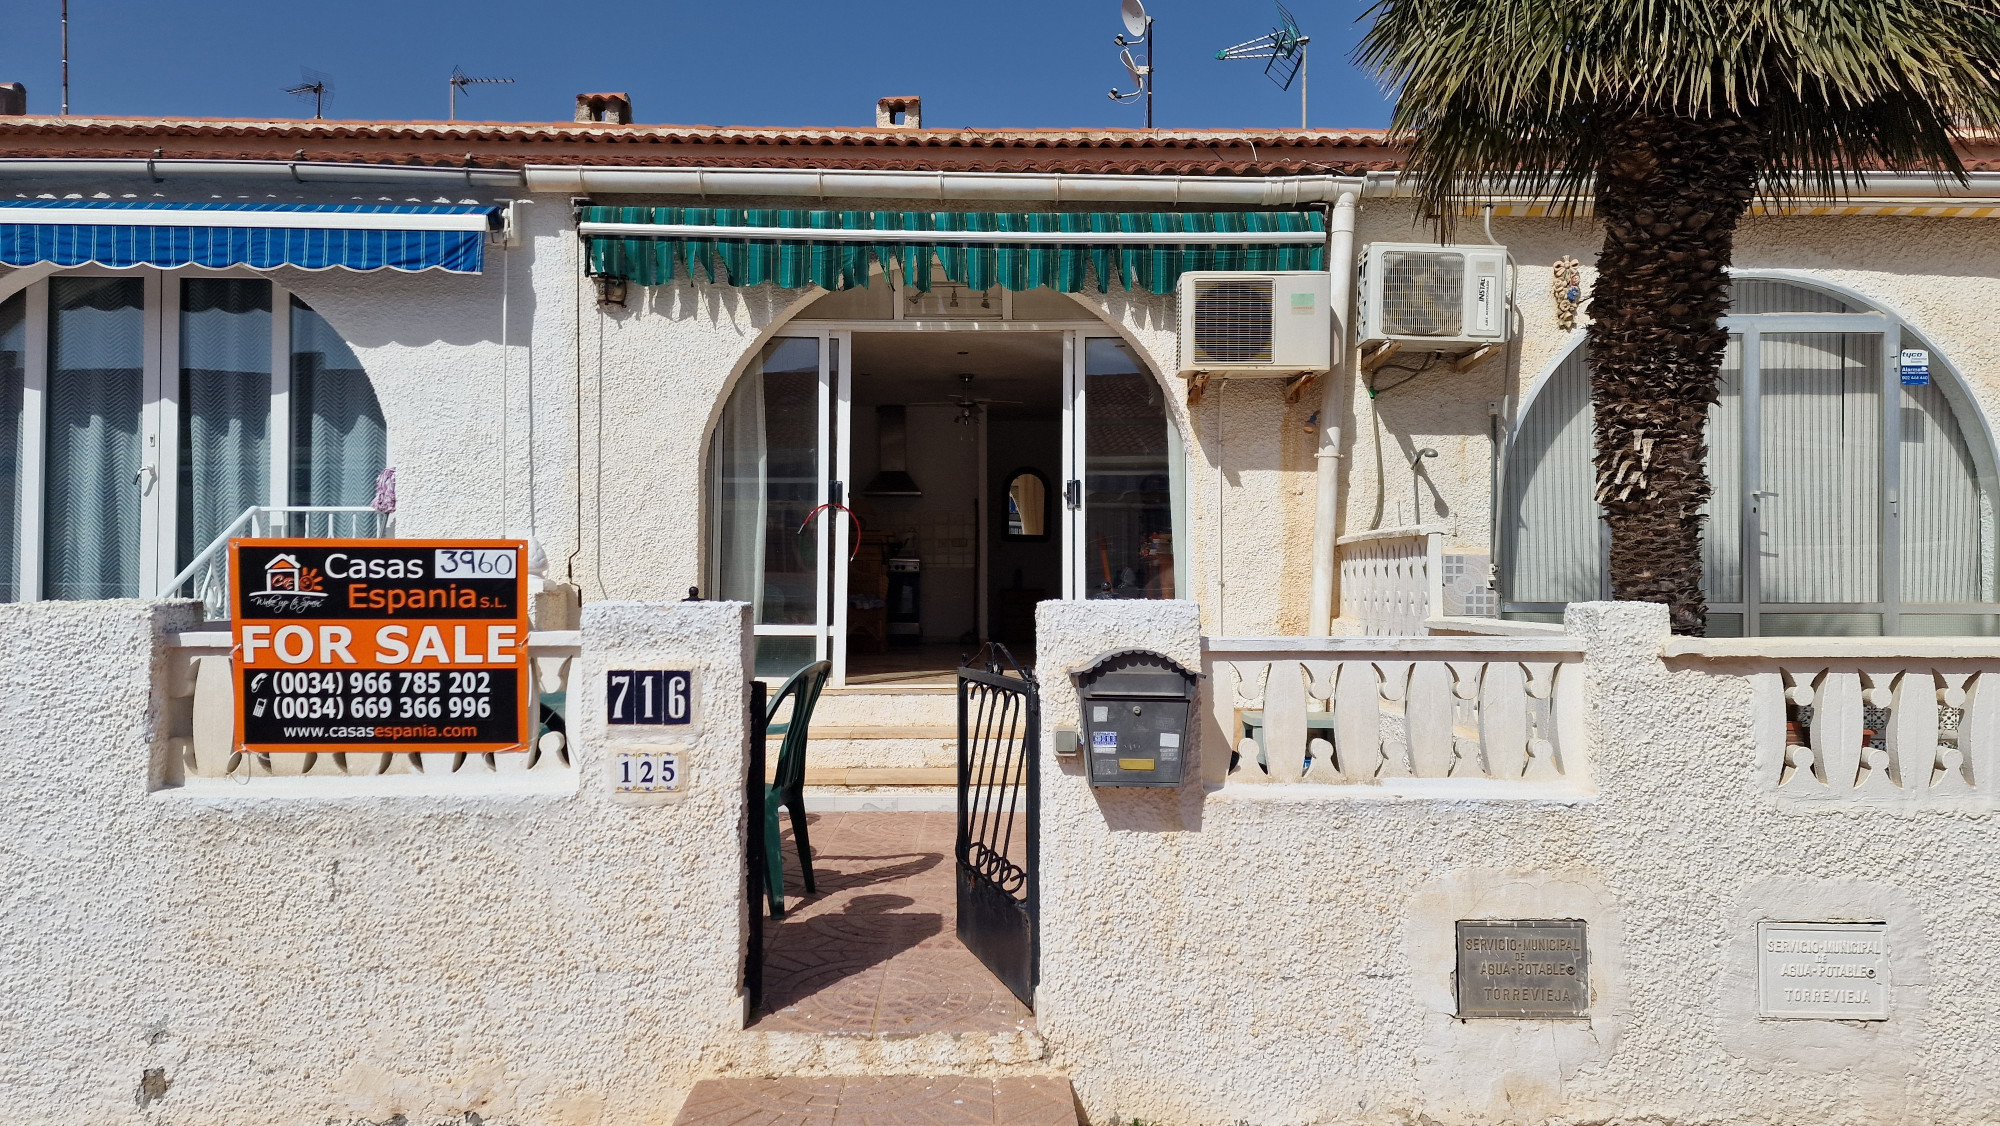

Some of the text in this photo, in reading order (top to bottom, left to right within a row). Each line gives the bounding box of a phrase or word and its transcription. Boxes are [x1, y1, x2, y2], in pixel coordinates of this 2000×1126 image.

[324, 553, 424, 579] Casas
[440, 549, 513, 576] 3960
[348, 583, 507, 614] Espania S.L.
[242, 625, 517, 665] FOR SALE
[272, 671, 491, 695] (0034) 966 785 202
[273, 696, 491, 720] (0034) 669 366 996
[611, 675, 686, 719] 716
[283, 724, 477, 740] www.casasespania.com
[621, 760, 675, 783] 125
[1515, 952, 1525, 962] DE
[1815, 954, 1828, 964] DE
[1484, 988, 1571, 1002] TORREVIEJA
[1784, 988, 1871, 1004] TORREVIEJA
